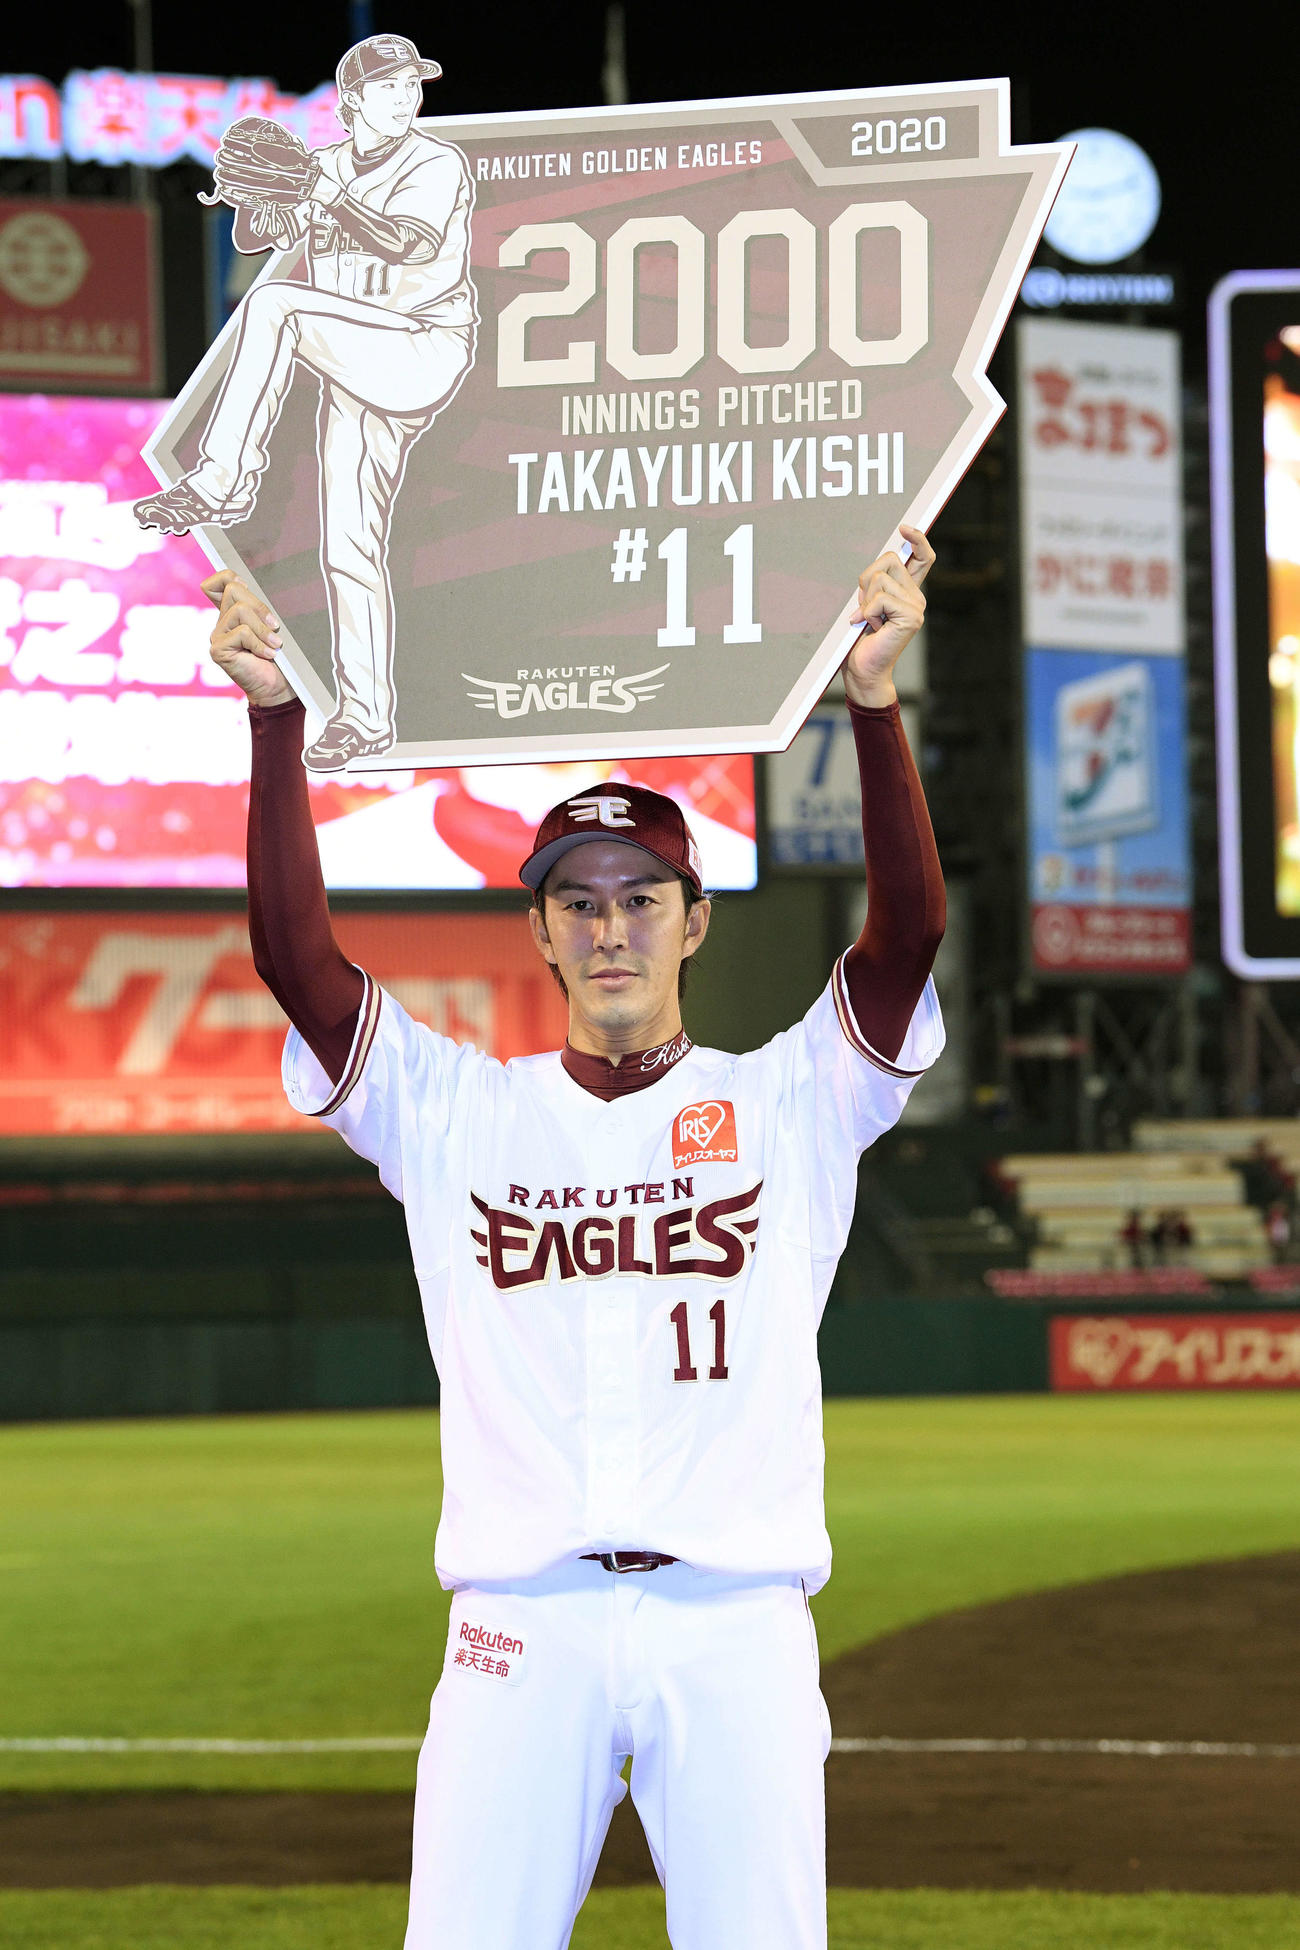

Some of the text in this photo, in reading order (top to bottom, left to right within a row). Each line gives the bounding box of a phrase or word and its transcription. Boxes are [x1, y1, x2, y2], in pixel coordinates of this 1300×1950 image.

[851, 115, 947, 157] 2020
[476, 140, 762, 181] RAKUTEN GOLDEN EAGLES
[363, 263, 391, 297] 11
[497, 200, 930, 388] 2000
[561, 379, 862, 436] INNINGS PITCHED
[508, 432, 904, 514] TAKAYUKI KISHI
[611, 524, 762, 648] #11
[461, 662, 671, 719] EAGLES
[516, 664, 616, 681] RAKUTEN
[675, 1148, 736, 1167] アイリスオーヤマ
[509, 1176, 695, 1210] RAKUTEN
[470, 1177, 764, 1294] EAGLES
[669, 1299, 730, 1384] 11
[460, 1621, 523, 1655] Rakuten
[454, 1648, 510, 1678] 楽天生命
